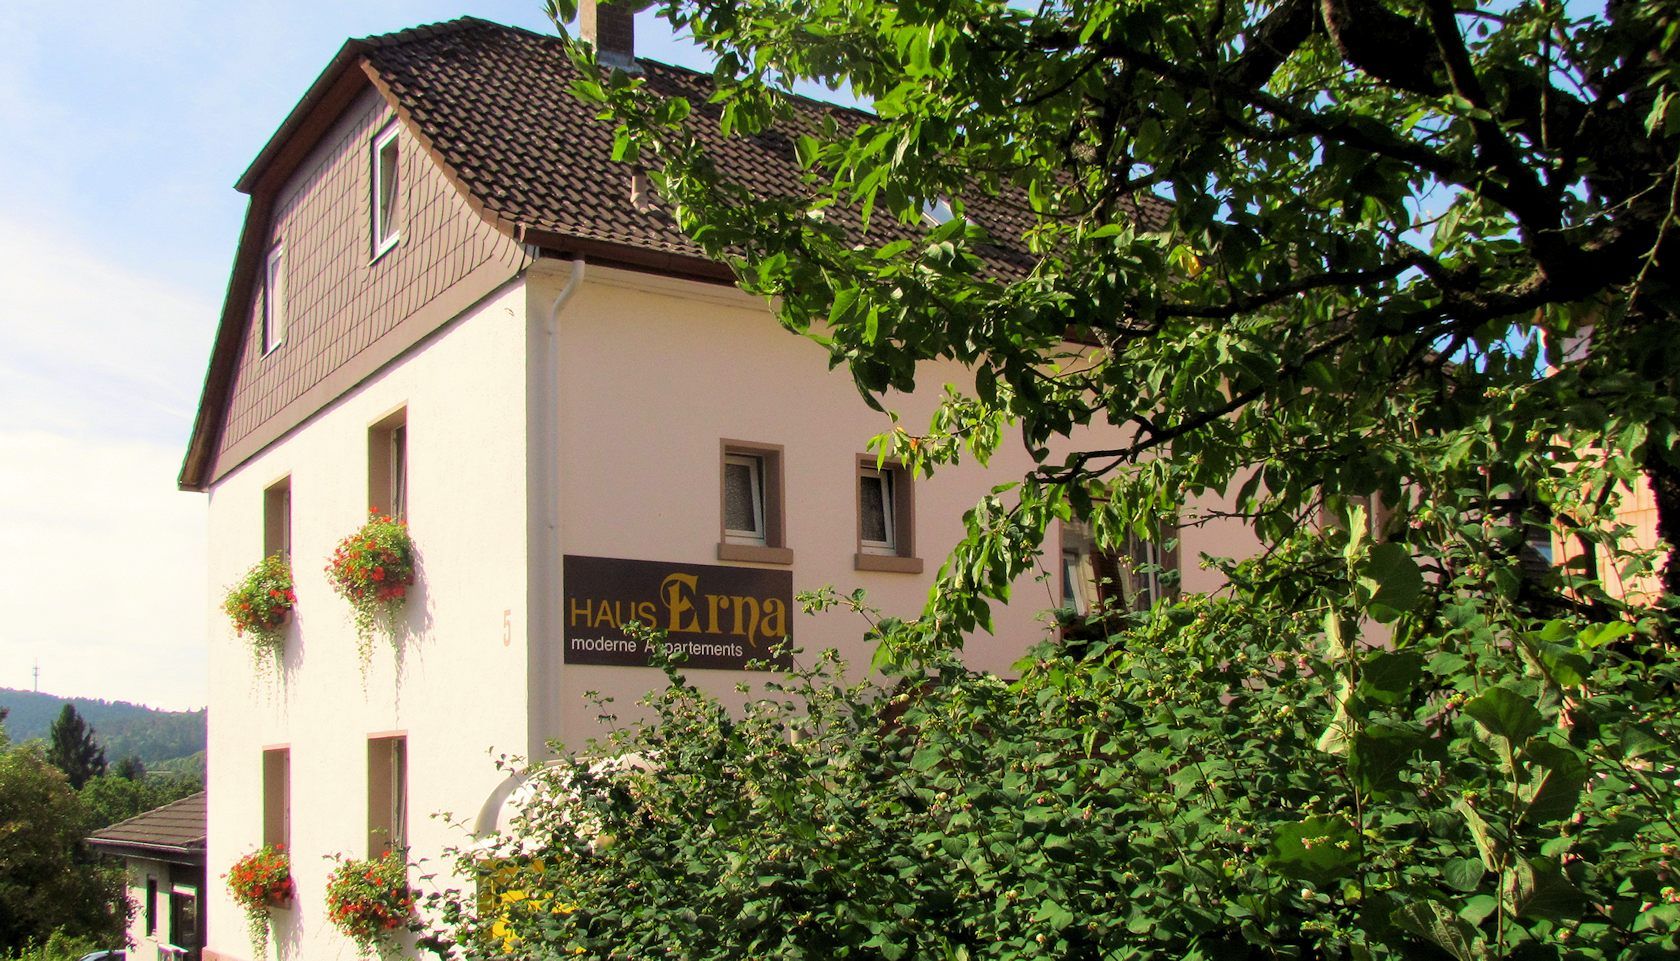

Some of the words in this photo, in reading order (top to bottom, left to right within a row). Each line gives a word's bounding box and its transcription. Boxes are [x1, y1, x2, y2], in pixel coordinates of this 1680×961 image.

[503, 608, 511, 647] 5
[571, 598, 657, 630] HAUS
[660, 572, 787, 648] Erna
[571, 636, 637, 652] moderne
[644, 639, 743, 657] Apartements
